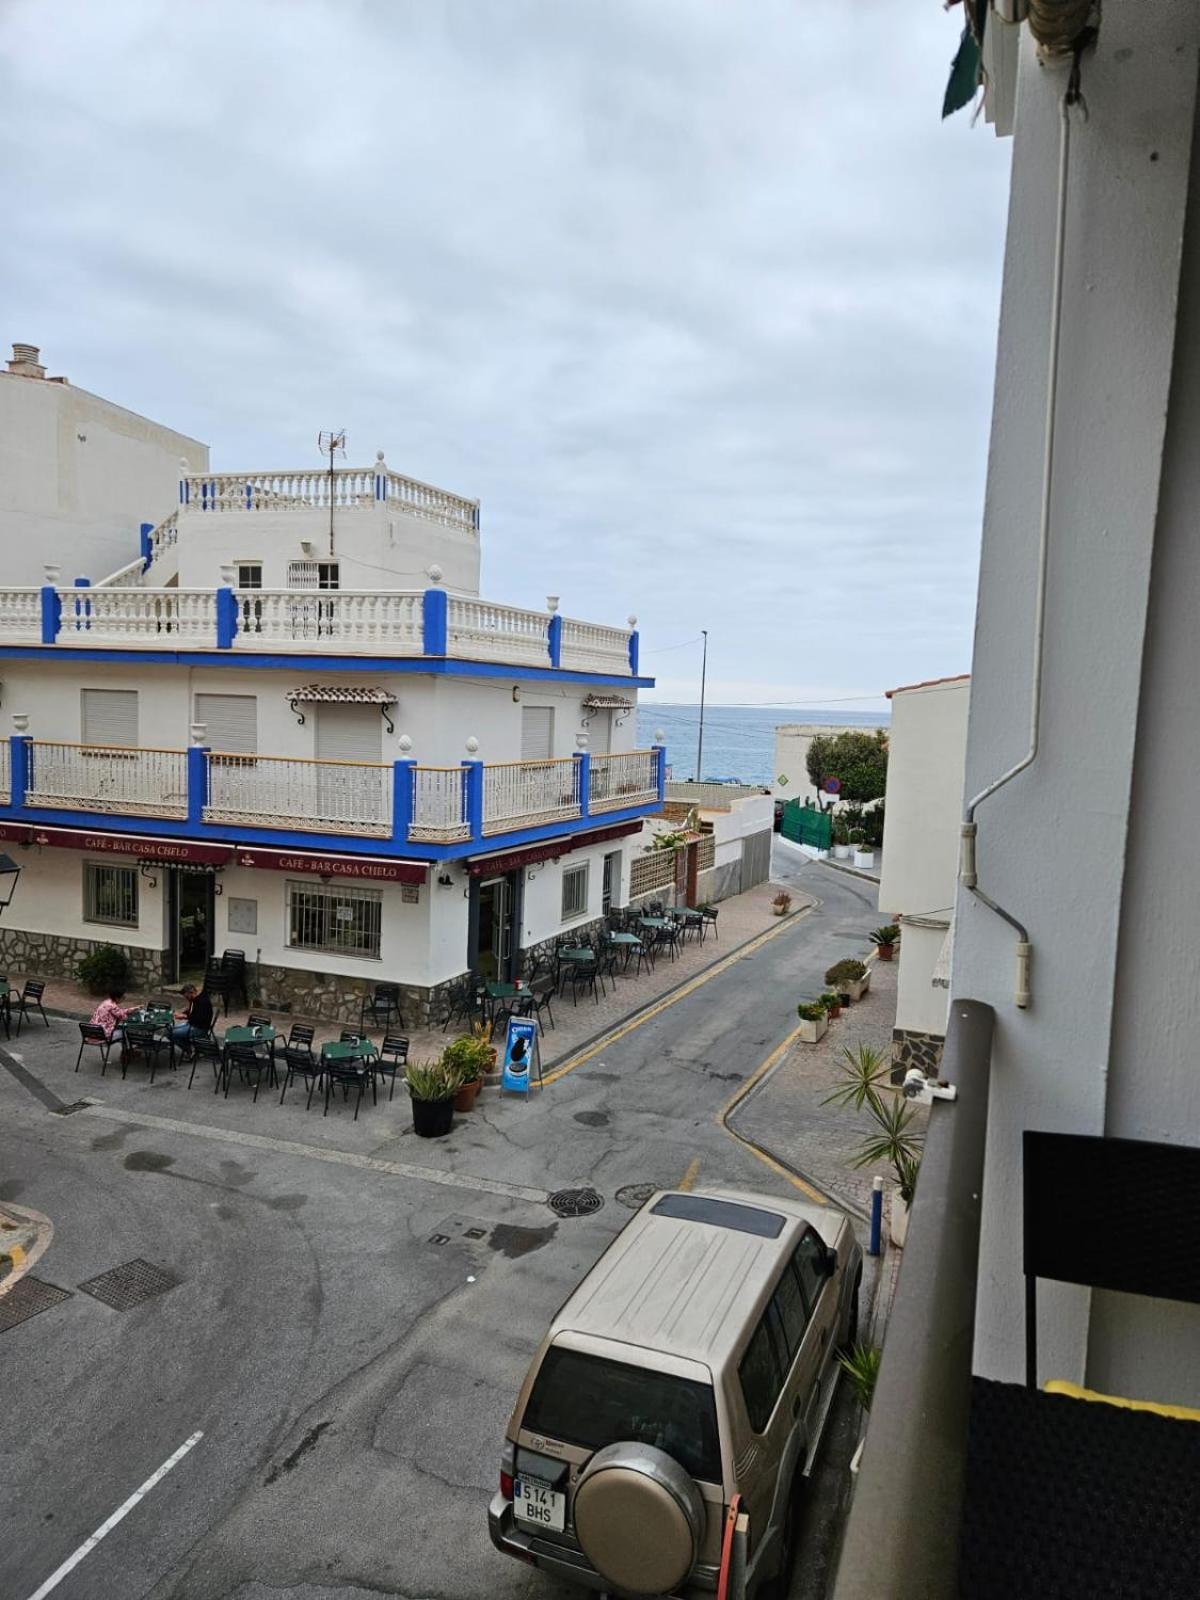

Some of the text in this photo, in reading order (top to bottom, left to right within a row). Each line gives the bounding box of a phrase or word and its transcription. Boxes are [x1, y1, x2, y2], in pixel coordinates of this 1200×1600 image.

[85, 838, 107, 848] CAFÉ
[113, 840, 132, 851] BAR
[132, 843, 155, 854] CASA
[157, 845, 189, 857] CHELO
[279, 857, 304, 869] CAFÉ
[311, 860, 331, 872] BAR
[332, 863, 359, 875] CASA
[361, 865, 397, 877] CHELO
[526, 1503, 552, 1522] BHS
